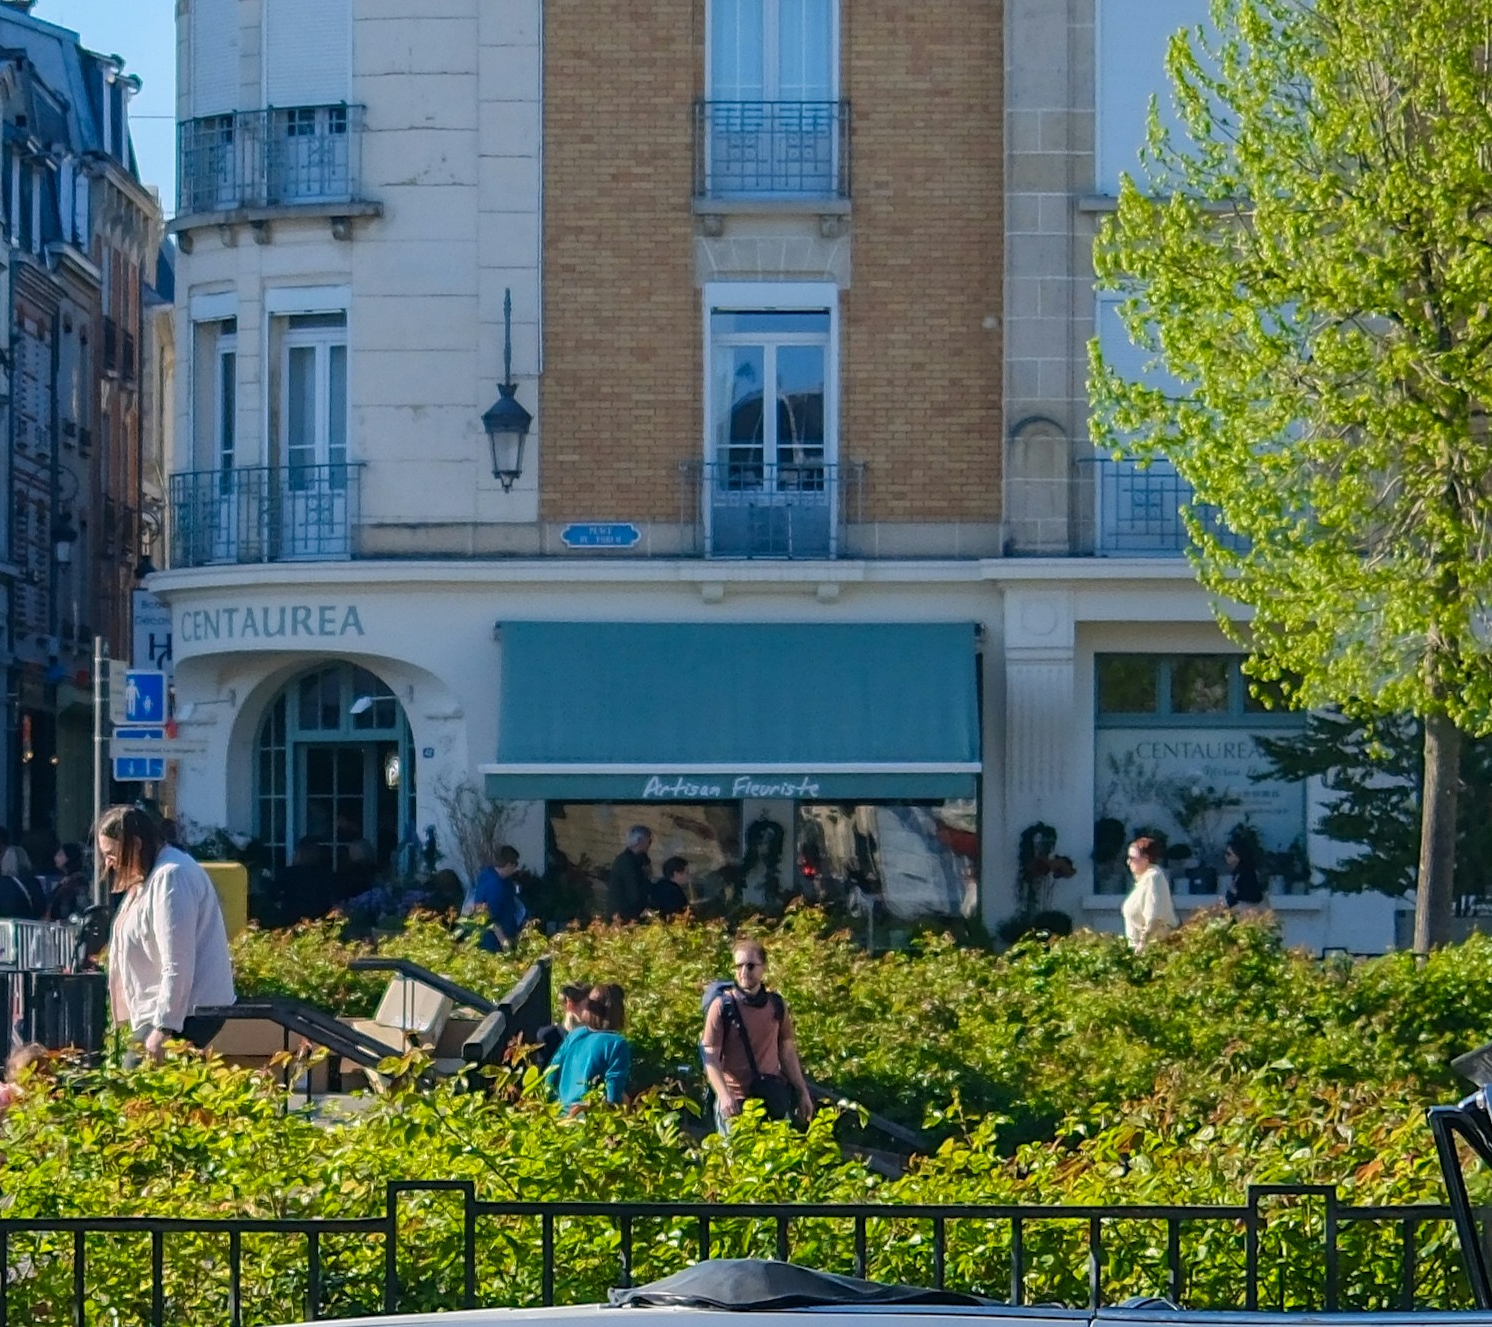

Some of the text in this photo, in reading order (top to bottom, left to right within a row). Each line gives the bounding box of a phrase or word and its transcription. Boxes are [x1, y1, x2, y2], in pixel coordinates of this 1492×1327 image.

[181, 605, 365, 642] CENTAUREA
[1136, 741, 1267, 759] CENTAUREA
[642, 776, 819, 798] Artisan Fleuriste
